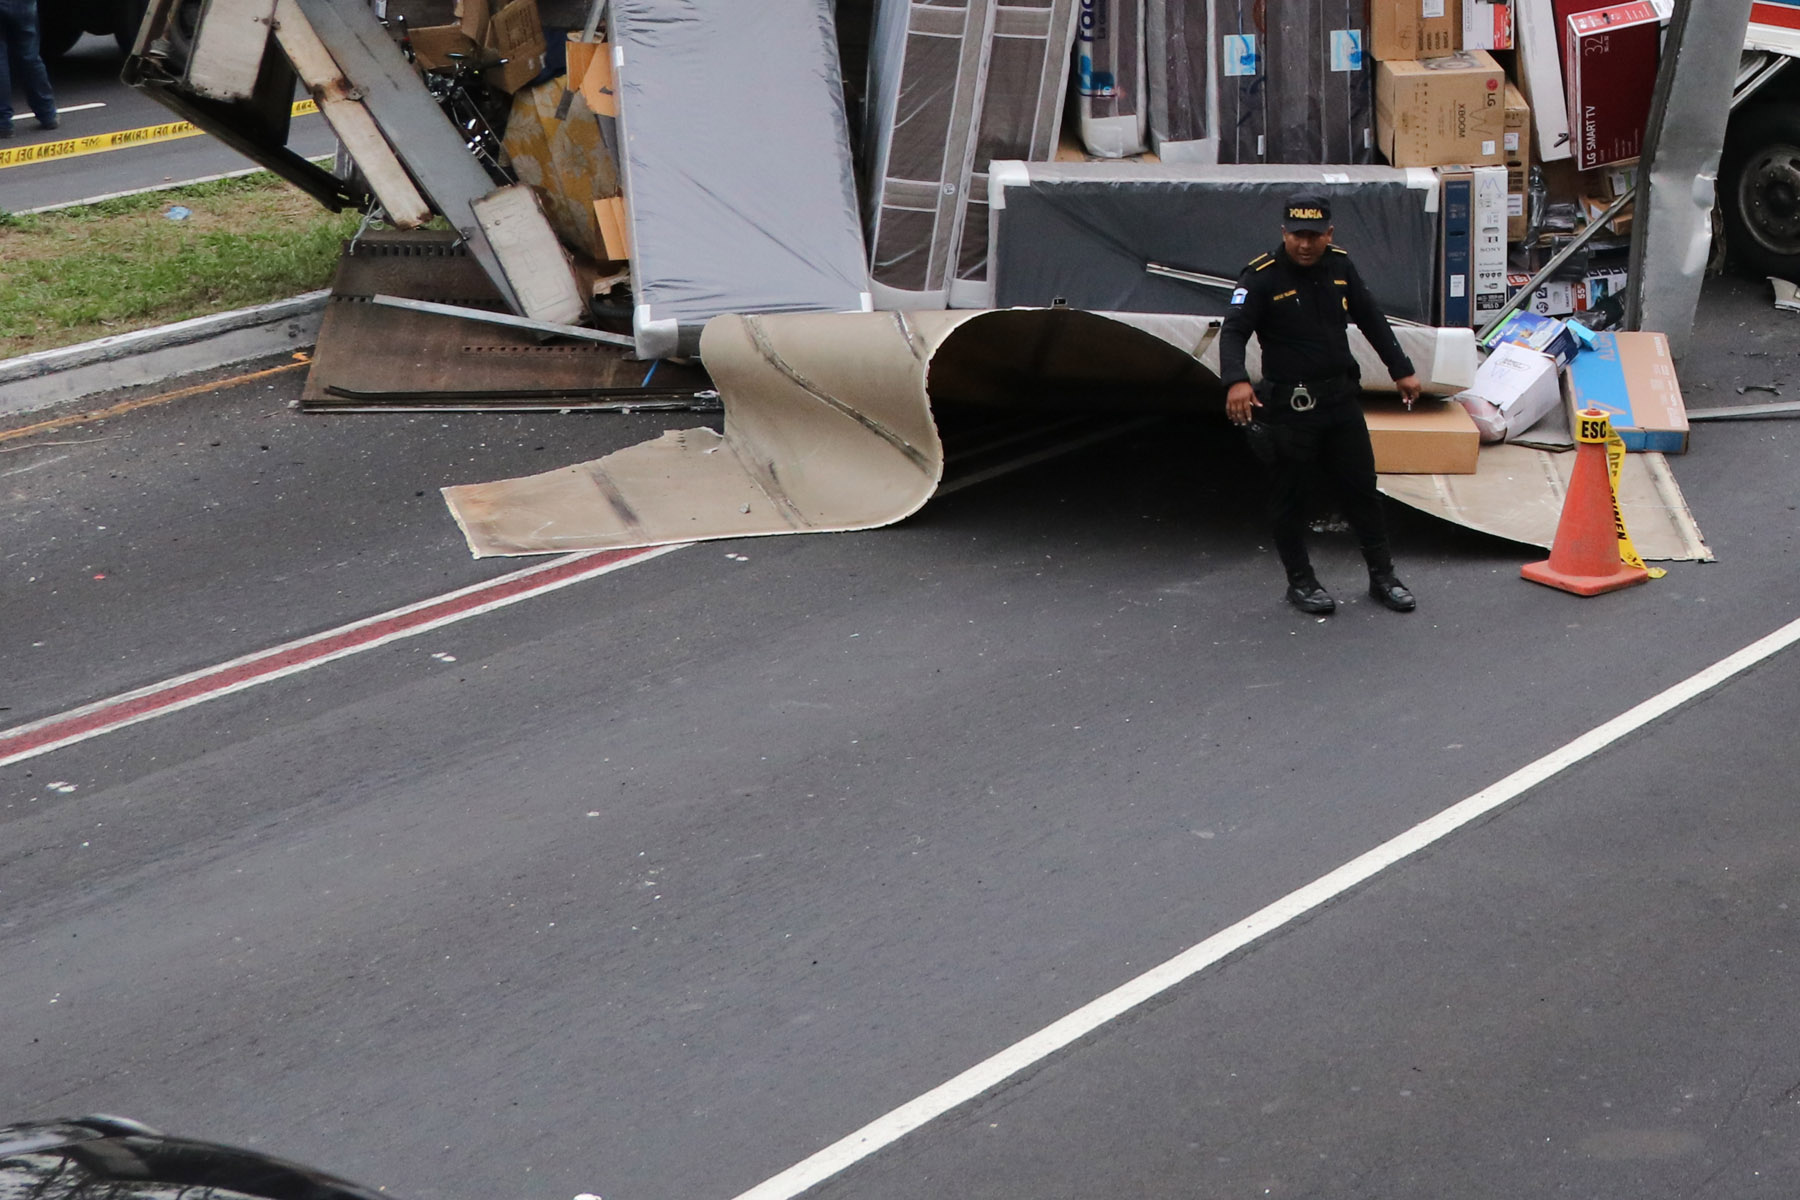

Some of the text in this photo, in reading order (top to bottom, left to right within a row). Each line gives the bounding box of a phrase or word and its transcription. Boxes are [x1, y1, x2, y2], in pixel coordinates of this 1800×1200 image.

[1584, 35, 1604, 57] 32
[1486, 92, 1497, 108] LG
[1457, 103, 1466, 138] XBOOM
[1585, 106, 1597, 165] LG SMART TV
[1581, 420, 1606, 439] ESC
